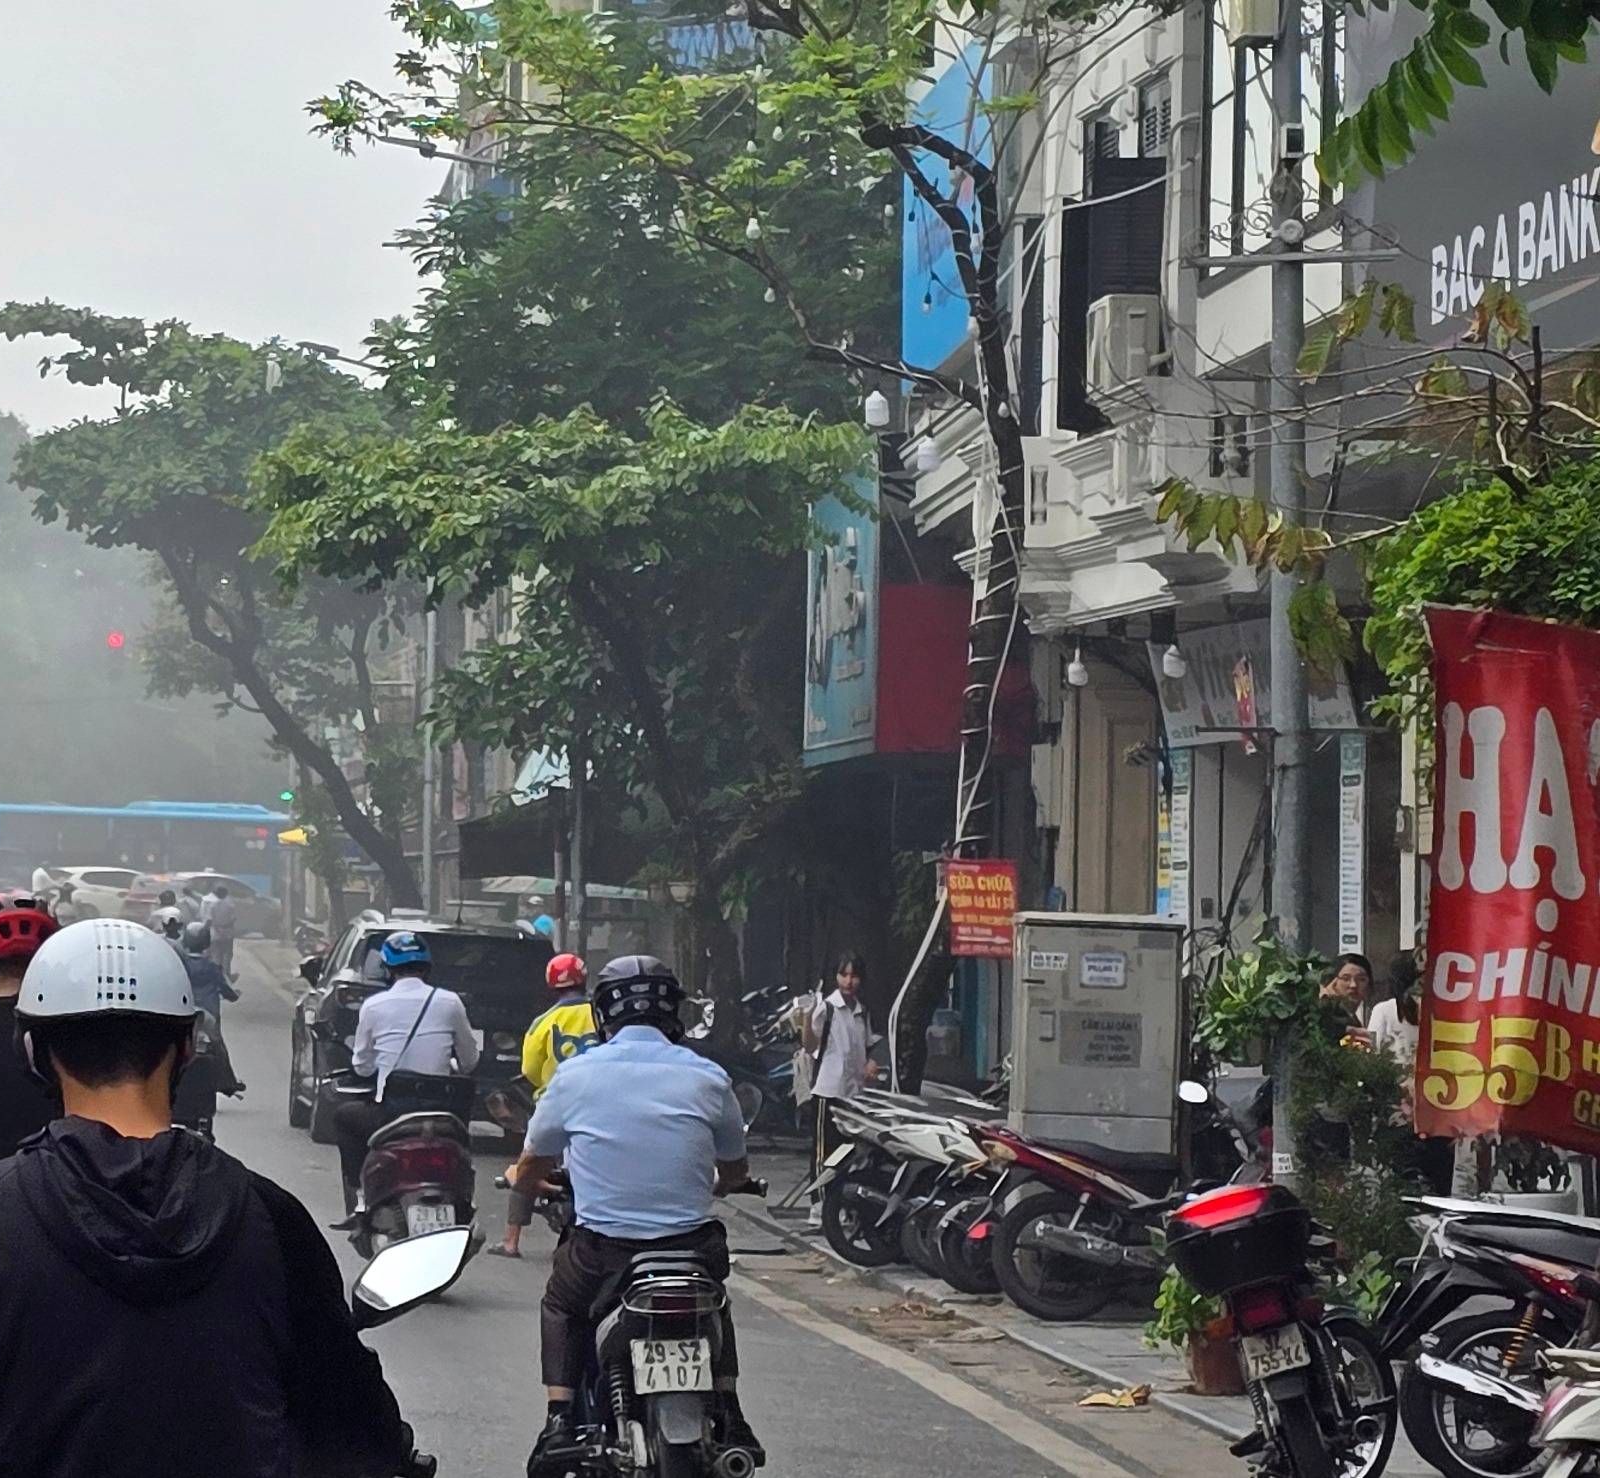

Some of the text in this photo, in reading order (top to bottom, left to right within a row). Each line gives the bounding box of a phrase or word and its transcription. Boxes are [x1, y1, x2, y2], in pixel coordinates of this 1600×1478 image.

[1431, 225, 1486, 326] BAC
[1517, 166, 1600, 287] BANK
[1439, 700, 1600, 933] HẠ
[1432, 941, 1600, 1020] CHÍN
[646, 1365, 701, 1389] 4107
